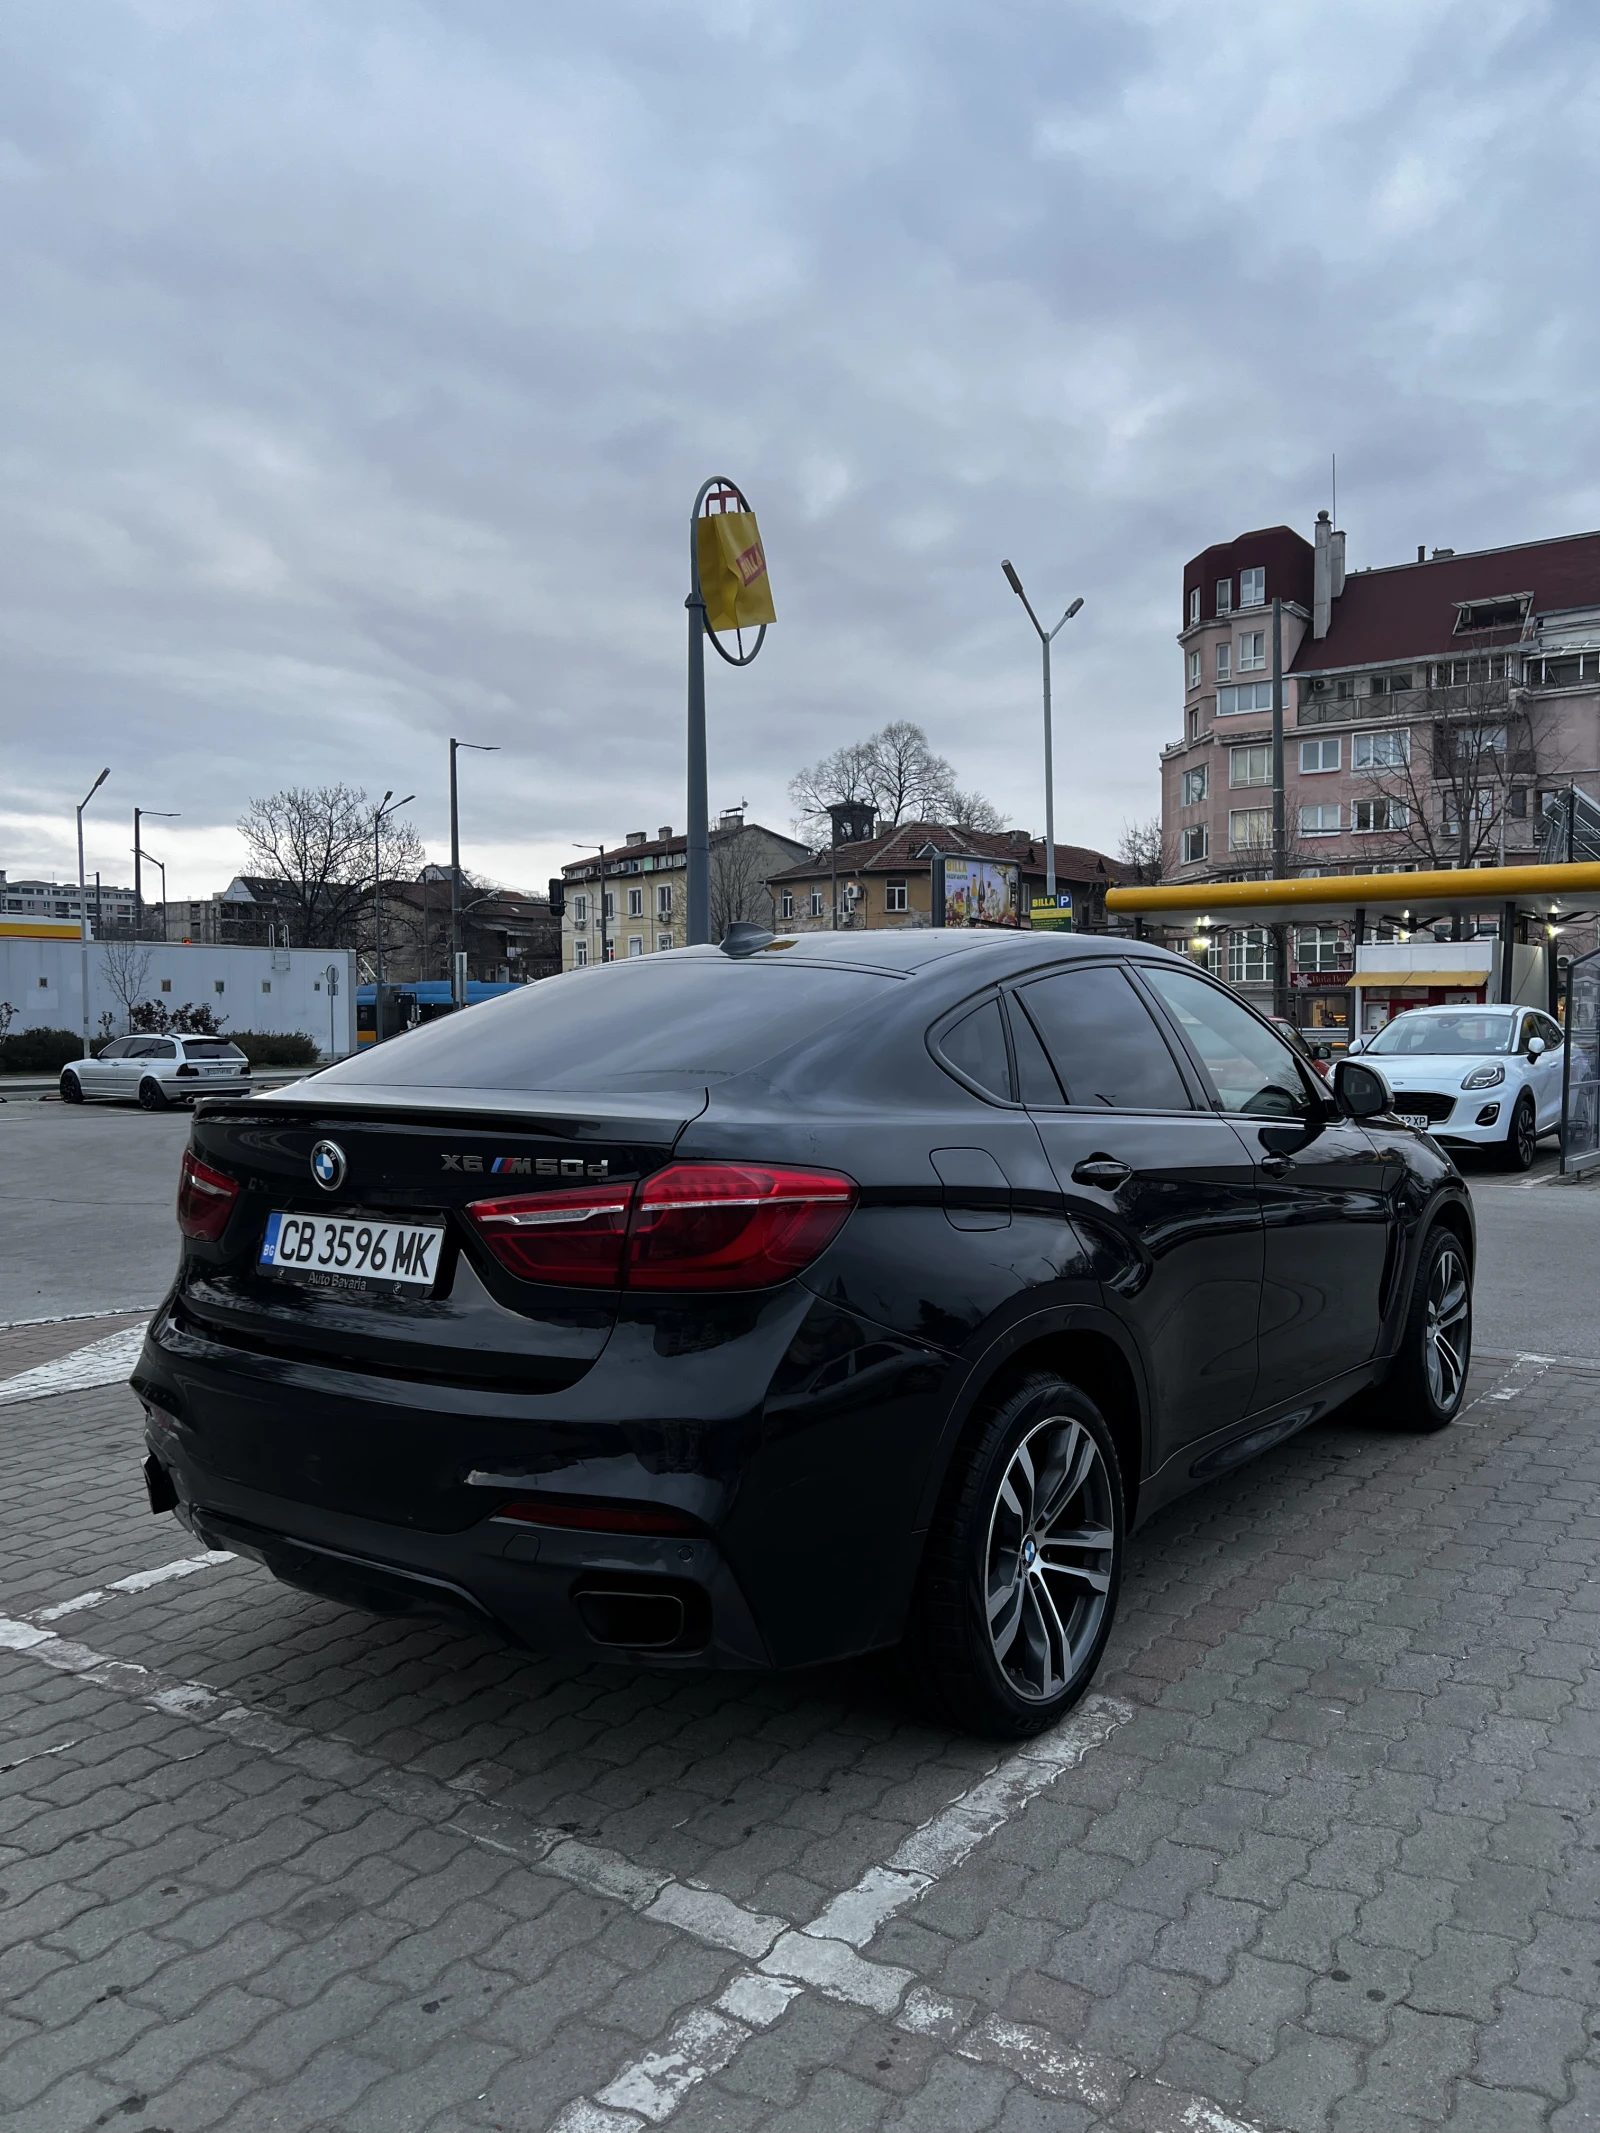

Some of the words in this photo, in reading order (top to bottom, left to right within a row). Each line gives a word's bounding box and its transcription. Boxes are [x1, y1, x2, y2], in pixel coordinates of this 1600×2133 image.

[946, 859, 967, 872] BILLA
[1031, 897, 1056, 908] BILLA
[1413, 1116, 1426, 1126] XP
[440, 1154, 484, 1173] X6
[263, 1244, 275, 1258] BG
[279, 1220, 316, 1263] CB
[317, 1223, 389, 1271] 3596
[391, 1231, 437, 1279] MK
[308, 1271, 331, 1286] Auto
[331, 1273, 368, 1291] Bavaria
